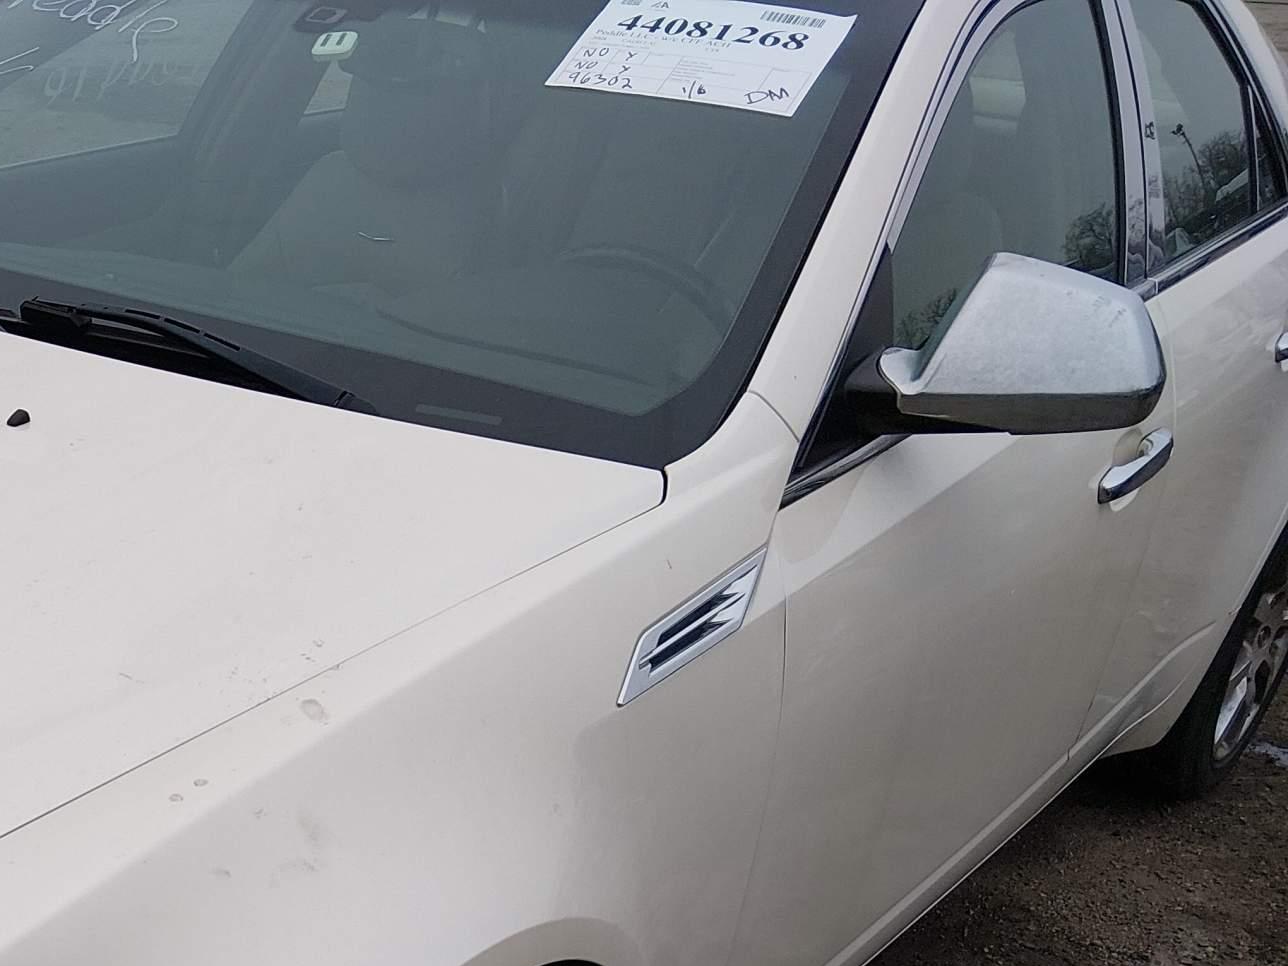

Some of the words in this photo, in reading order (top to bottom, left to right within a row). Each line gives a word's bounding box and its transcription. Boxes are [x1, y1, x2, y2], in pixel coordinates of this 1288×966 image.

[617, 14, 810, 51] 44081268
[583, 47, 610, 57] NO
[574, 61, 598, 70] NO
[568, 71, 633, 89] 96302
